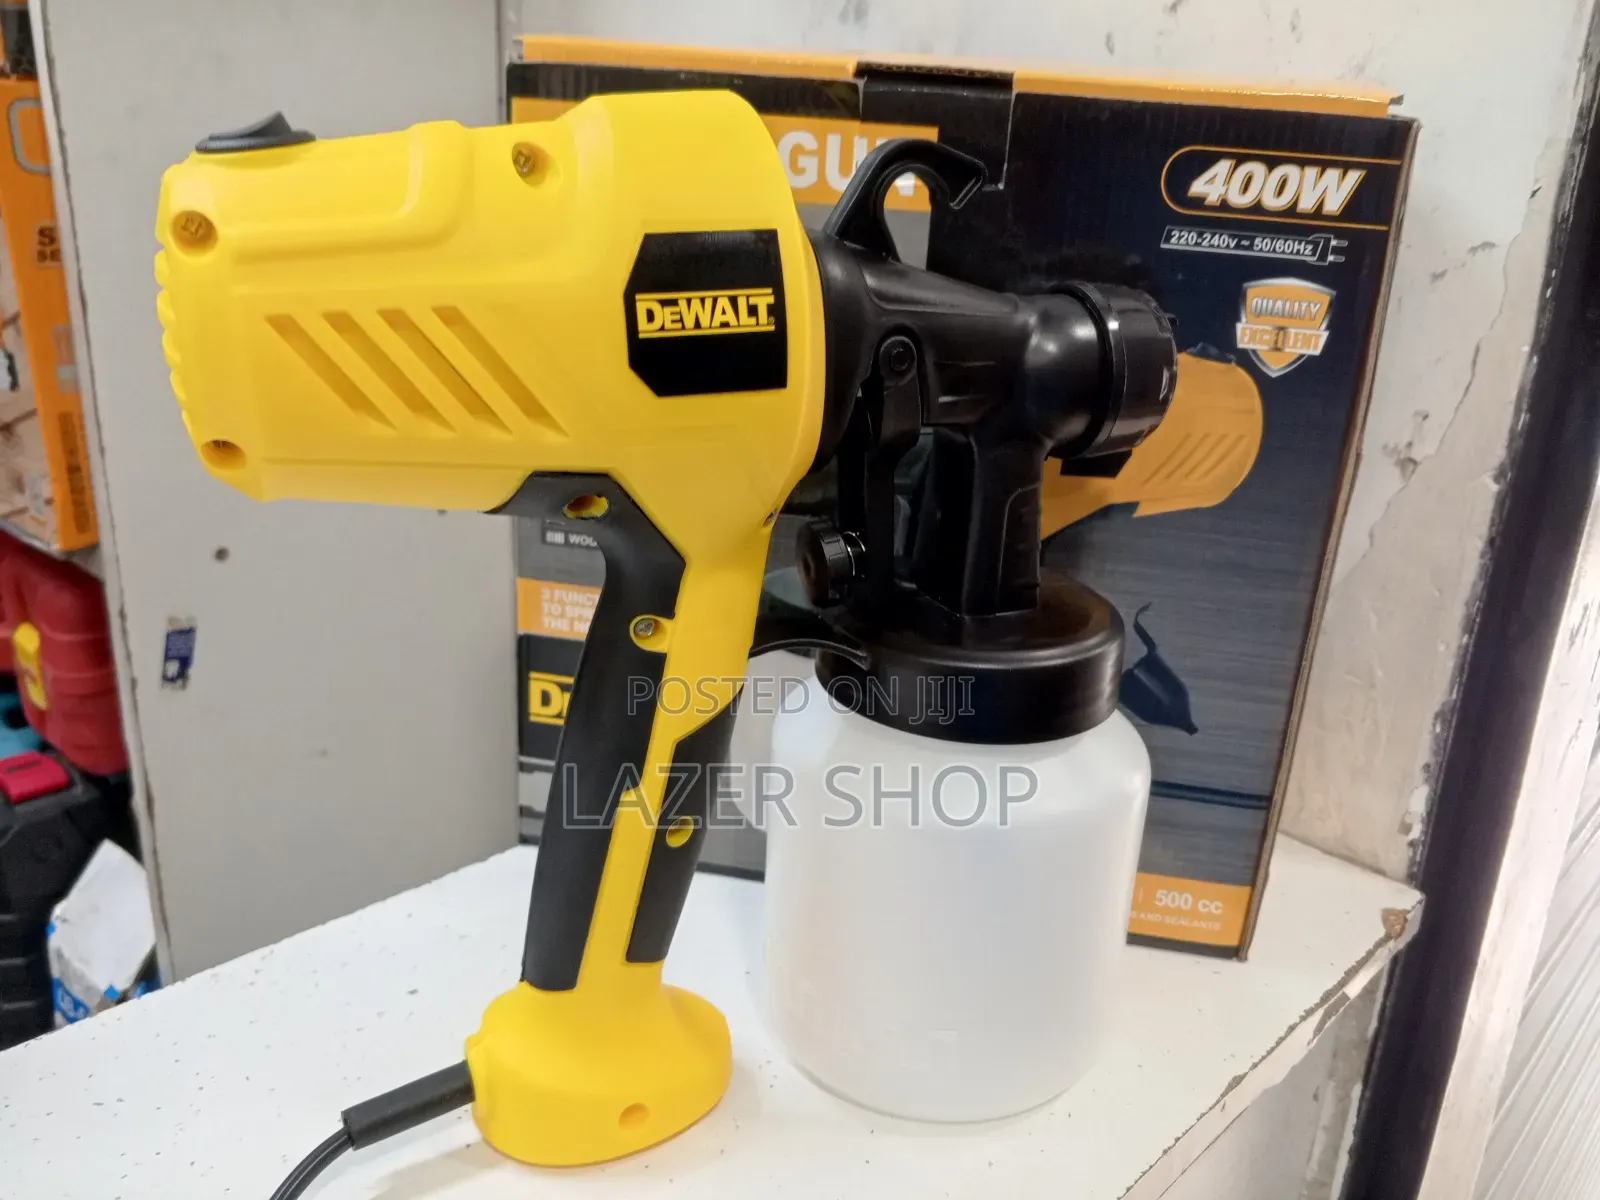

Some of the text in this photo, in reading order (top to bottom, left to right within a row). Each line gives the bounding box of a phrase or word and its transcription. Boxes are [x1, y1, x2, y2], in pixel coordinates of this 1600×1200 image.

[777, 130, 917, 197] GU
[1187, 157, 1366, 216] 400W
[1169, 230, 1238, 249] 220-240v
[1253, 237, 1314, 256] 50/60Hz
[1251, 297, 1321, 321] QUALITY
[1155, 888, 1224, 915] 500 cc
